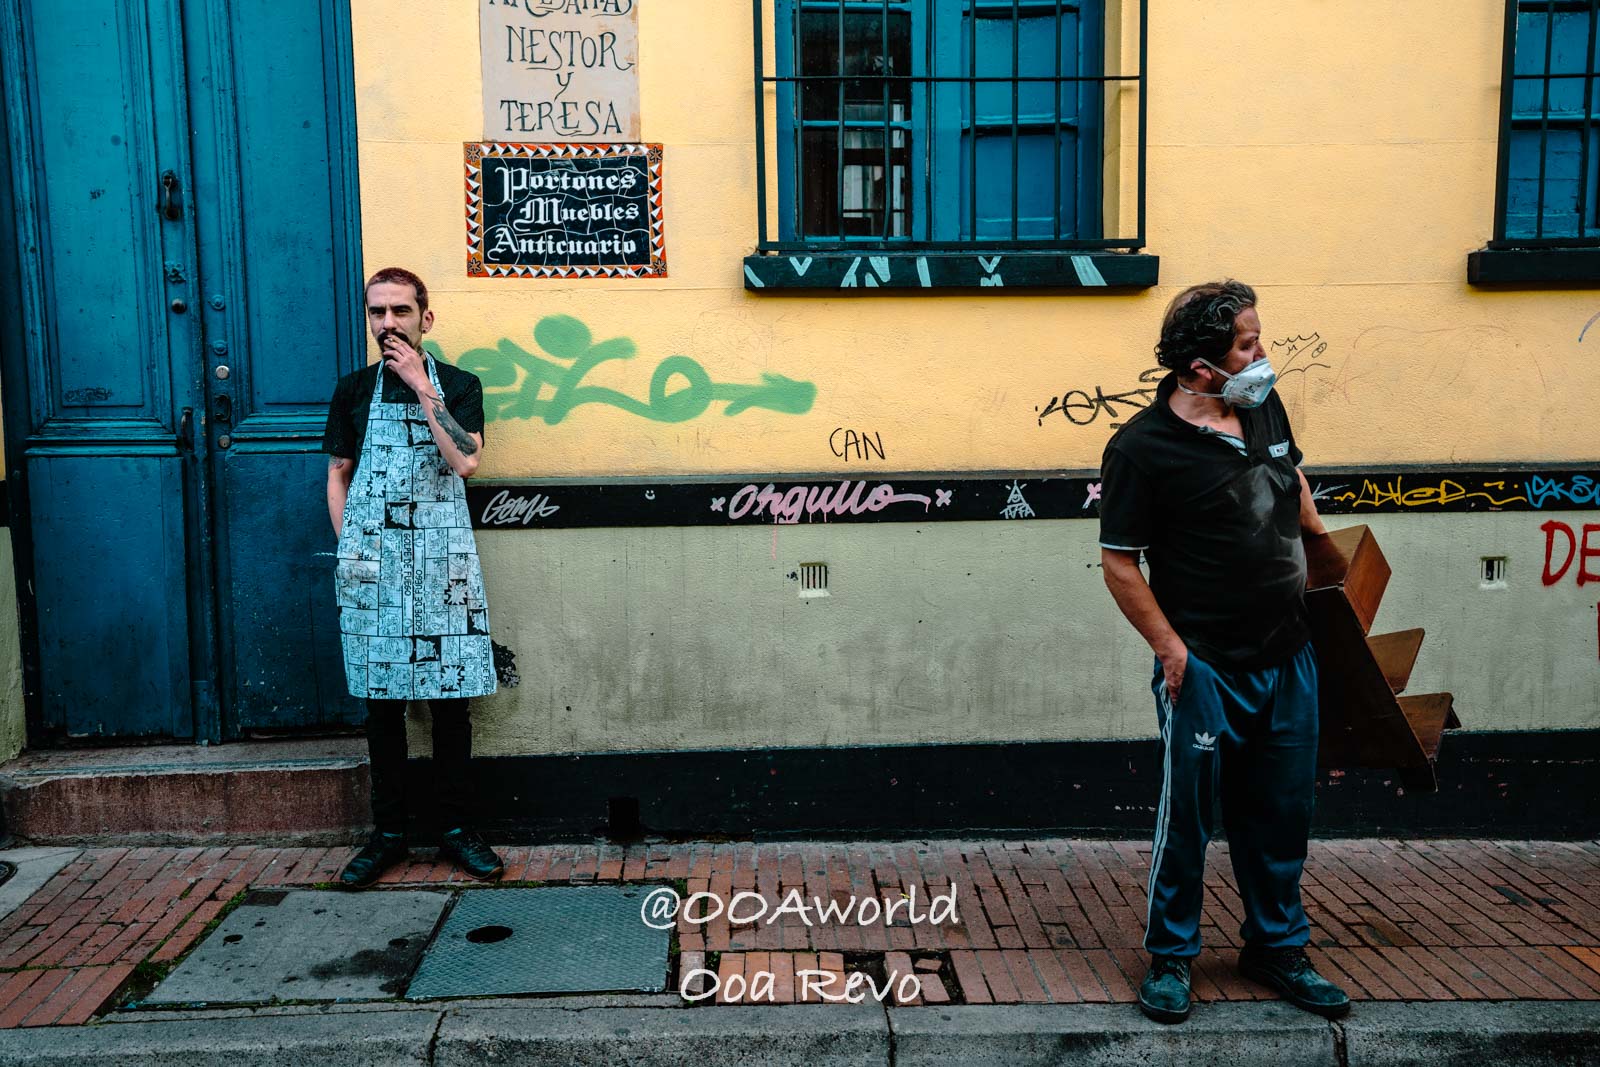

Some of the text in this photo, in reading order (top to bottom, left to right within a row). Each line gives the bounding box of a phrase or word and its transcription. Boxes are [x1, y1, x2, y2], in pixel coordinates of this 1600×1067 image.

[506, 25, 635, 71] NESTOR
[500, 99, 623, 137] TERESA
[494, 167, 637, 203] Portones
[512, 197, 640, 232] Muebles
[487, 226, 637, 261] Anticuario
[829, 427, 886, 462] CAN
